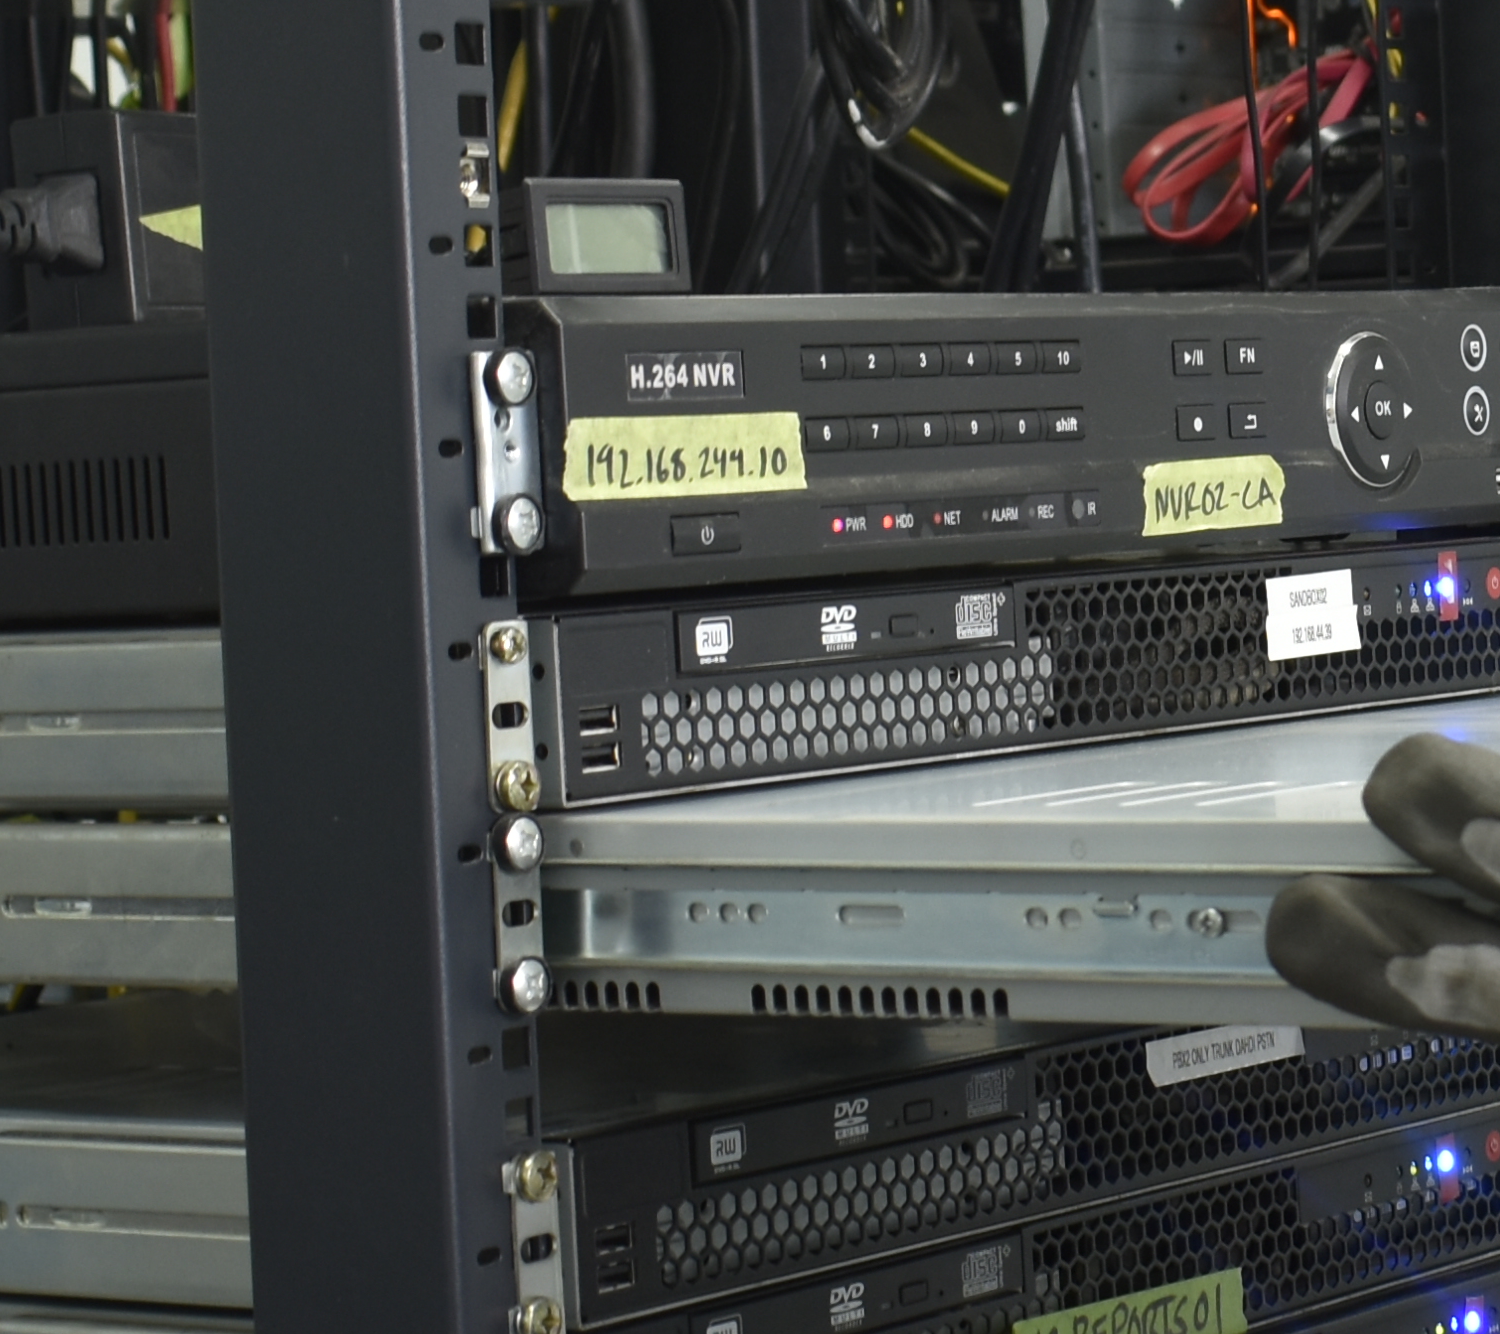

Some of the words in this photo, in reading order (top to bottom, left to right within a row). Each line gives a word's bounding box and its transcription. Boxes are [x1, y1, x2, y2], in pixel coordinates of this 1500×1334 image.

[819, 354, 827, 369] 1
[868, 353, 876, 369] 2
[919, 352, 927, 368] 3
[967, 351, 975, 367] 4
[1015, 350, 1023, 366] 5
[1057, 350, 1070, 366] 10
[1240, 348, 1255, 364] FN
[631, 363, 688, 389] H.264
[693, 363, 736, 387] NVR
[1375, 401, 1392, 417] OK
[823, 424, 831, 441] 6
[871, 423, 879, 439] 7
[924, 422, 931, 437] 8
[971, 419, 978, 435] 9
[1018, 418, 1026, 434] 0
[1055, 416, 1078, 433] shift
[1155, 477, 1277, 524] NVR02-CA
[846, 516, 867, 532] PWR
[896, 513, 914, 528] HDD
[944, 510, 961, 526] NET
[991, 507, 1019, 522] ALARM
[1037, 505, 1055, 519] REC
[1087, 502, 1097, 516] IR
[821, 605, 857, 624] DVD
[702, 630, 723, 648] RW
[1191, 1045, 1210, 1064] ONLY
[1211, 1039, 1235, 1061] TRUNK
[834, 1098, 869, 1119] DVD
[716, 1139, 736, 1156] RW
[830, 1281, 865, 1306] DVD
